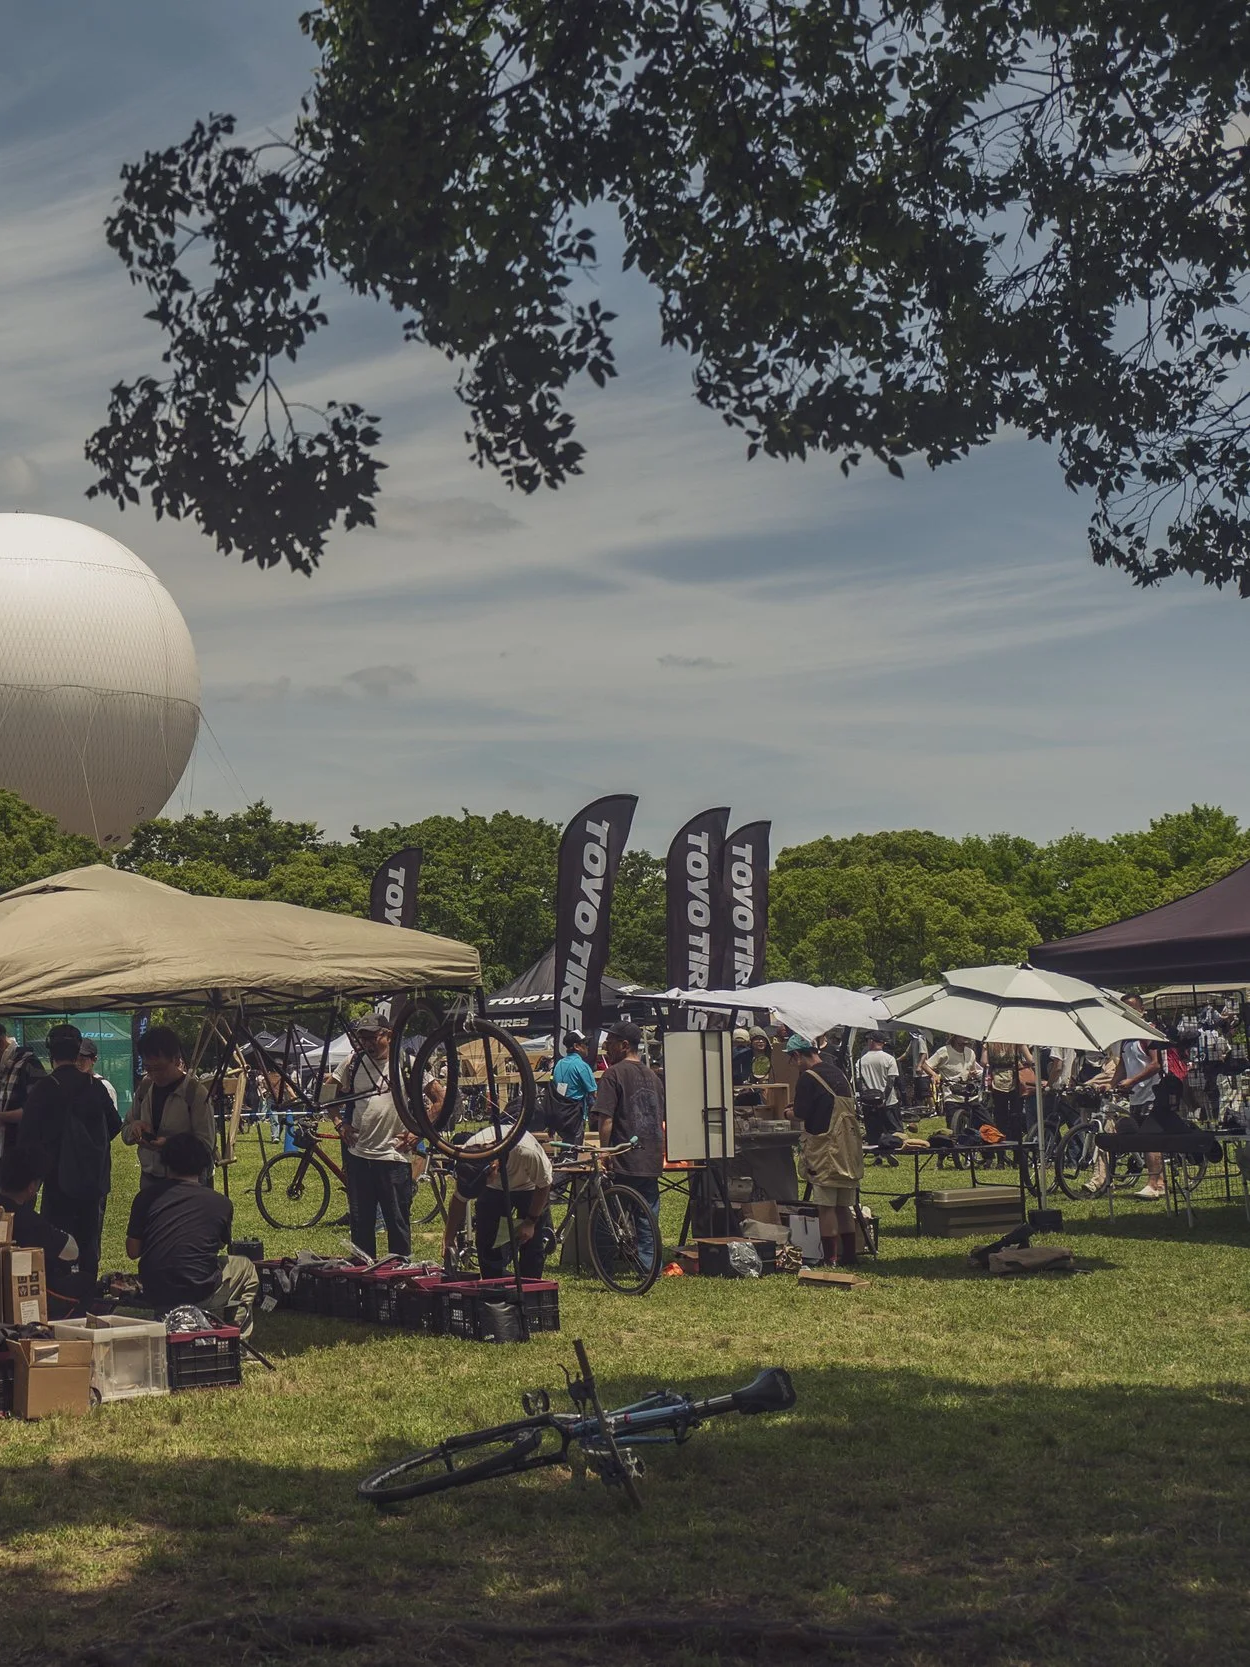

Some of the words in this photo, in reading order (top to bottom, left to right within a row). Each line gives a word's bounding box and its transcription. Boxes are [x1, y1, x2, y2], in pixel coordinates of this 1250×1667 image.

[385, 866, 406, 927] TOY
[574, 819, 610, 936] TOYO
[686, 831, 711, 928] TOYO
[731, 843, 755, 931] TOYO
[488, 994, 540, 1006] TOYO
[493, 1017, 529, 1028] TIRES
[686, 932, 711, 1031] TIRS
